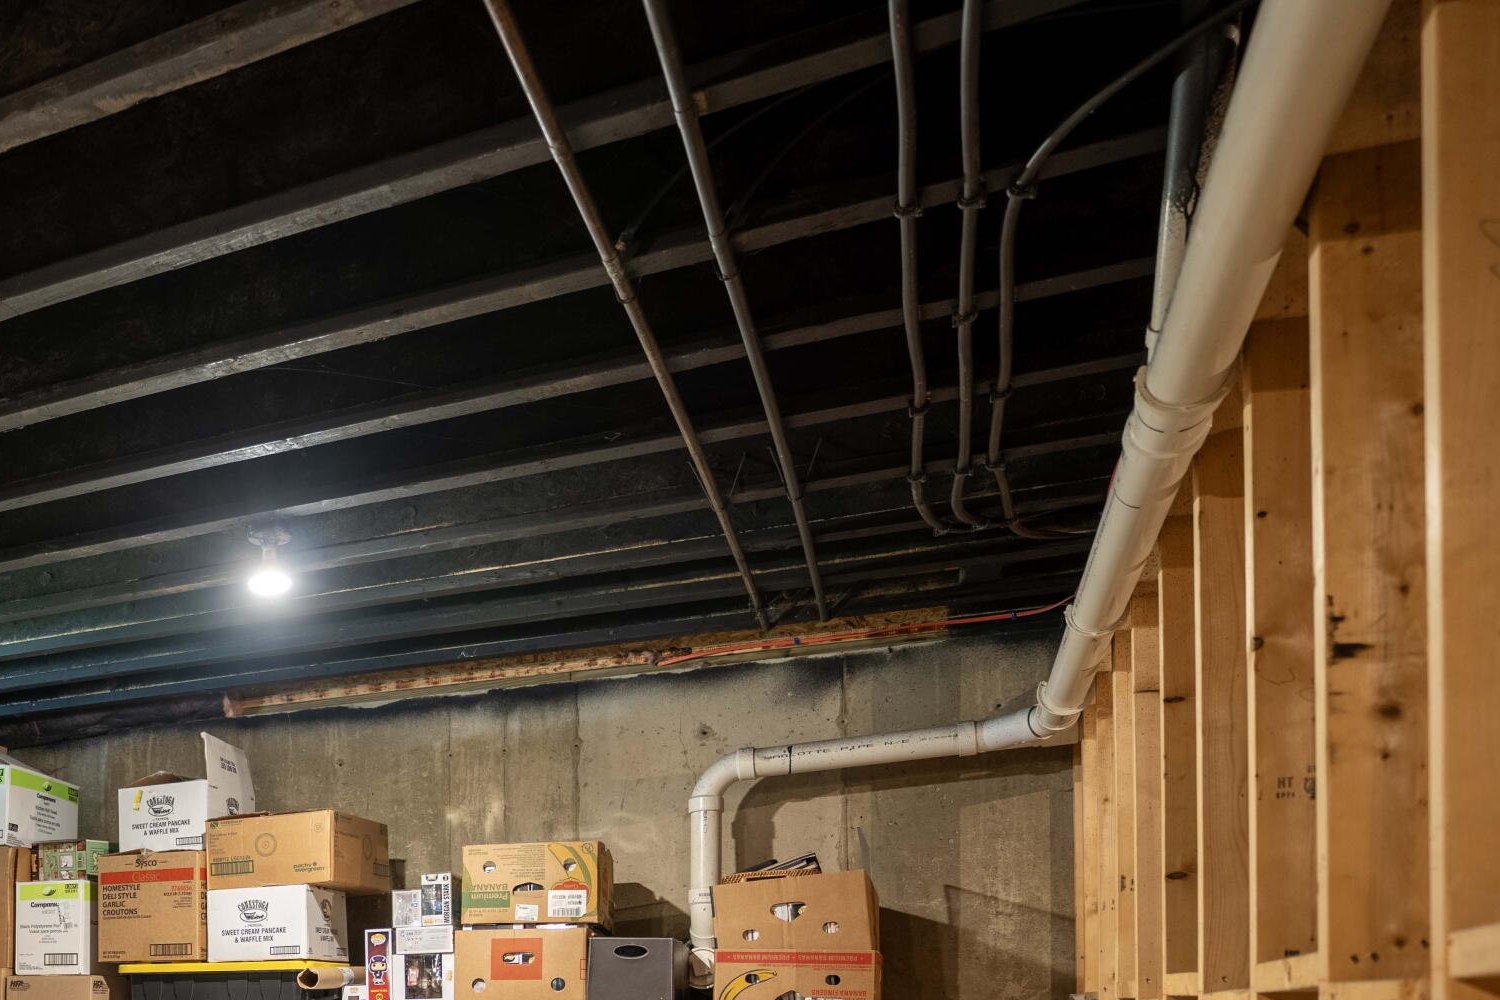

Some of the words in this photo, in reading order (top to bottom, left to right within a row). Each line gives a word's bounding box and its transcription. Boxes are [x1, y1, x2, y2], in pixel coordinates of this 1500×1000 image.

[132, 823, 148, 831] SWEET
[149, 821, 167, 829] CREAM
[167, 819, 191, 827] PANCAKE
[149, 828, 169, 836] WAFFLE
[135, 858, 157, 869] Sysco
[131, 871, 160, 882] Classic
[102, 884, 141, 892] HOMESTYLE
[471, 892, 508, 900] Premium
[102, 900, 126, 908] GARLIC
[102, 908, 138, 916] CROUTONS
[221, 928, 240, 936] SWEET
[240, 927, 260, 935] CREAM
[261, 926, 287, 934] PANCAKE
[240, 935, 262, 943] WAFFLE
[263, 934, 274, 942] MIX
